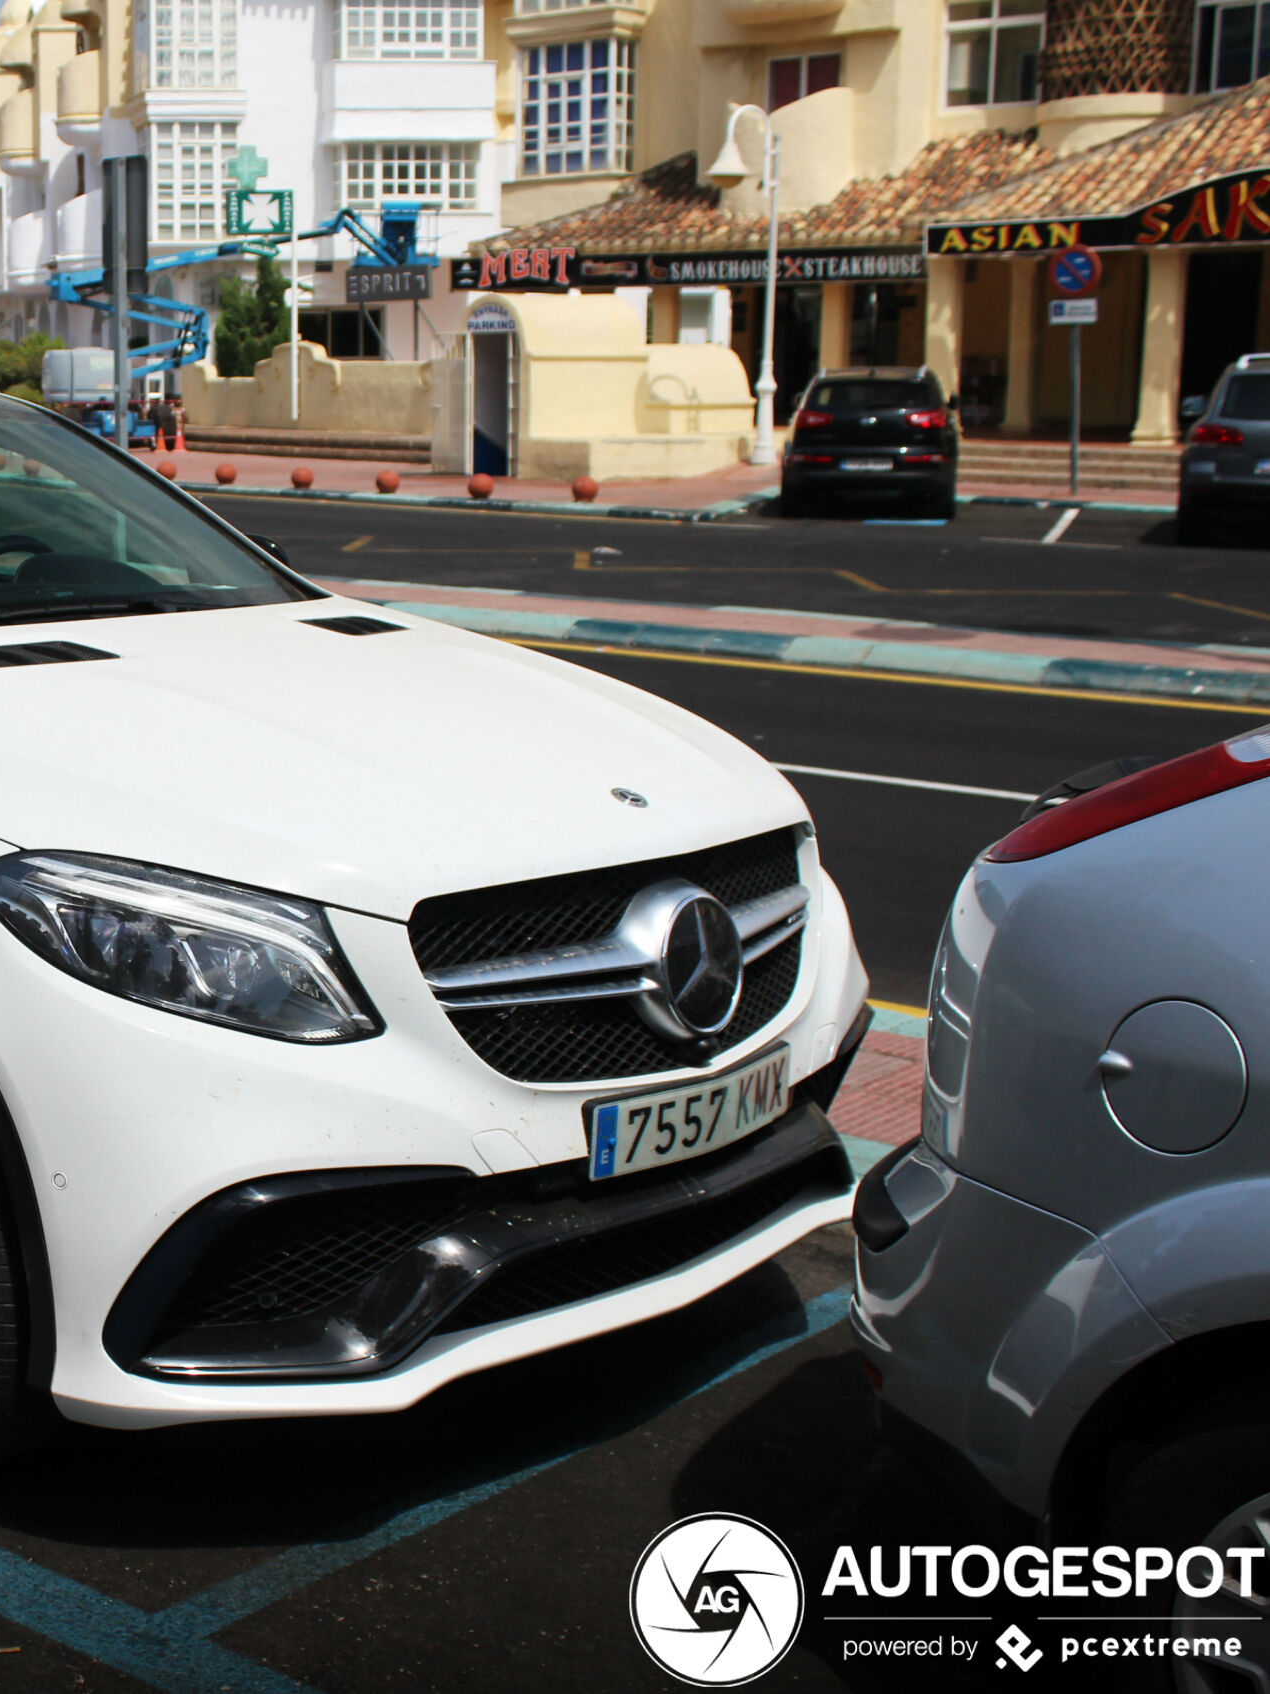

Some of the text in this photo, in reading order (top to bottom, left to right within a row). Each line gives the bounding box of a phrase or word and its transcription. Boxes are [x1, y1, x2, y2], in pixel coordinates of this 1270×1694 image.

[230, 191, 239, 233] FARMACIA
[283, 191, 292, 233] FARMACIA
[939, 222, 1080, 252] ASIAN
[348, 272, 411, 295] ESPRIT
[478, 247, 575, 289] MEAT
[804, 254, 921, 278] STEAKHOUSE
[467, 319, 515, 330] PARKING
[599, 1056, 786, 1165] E 7557 KMX
